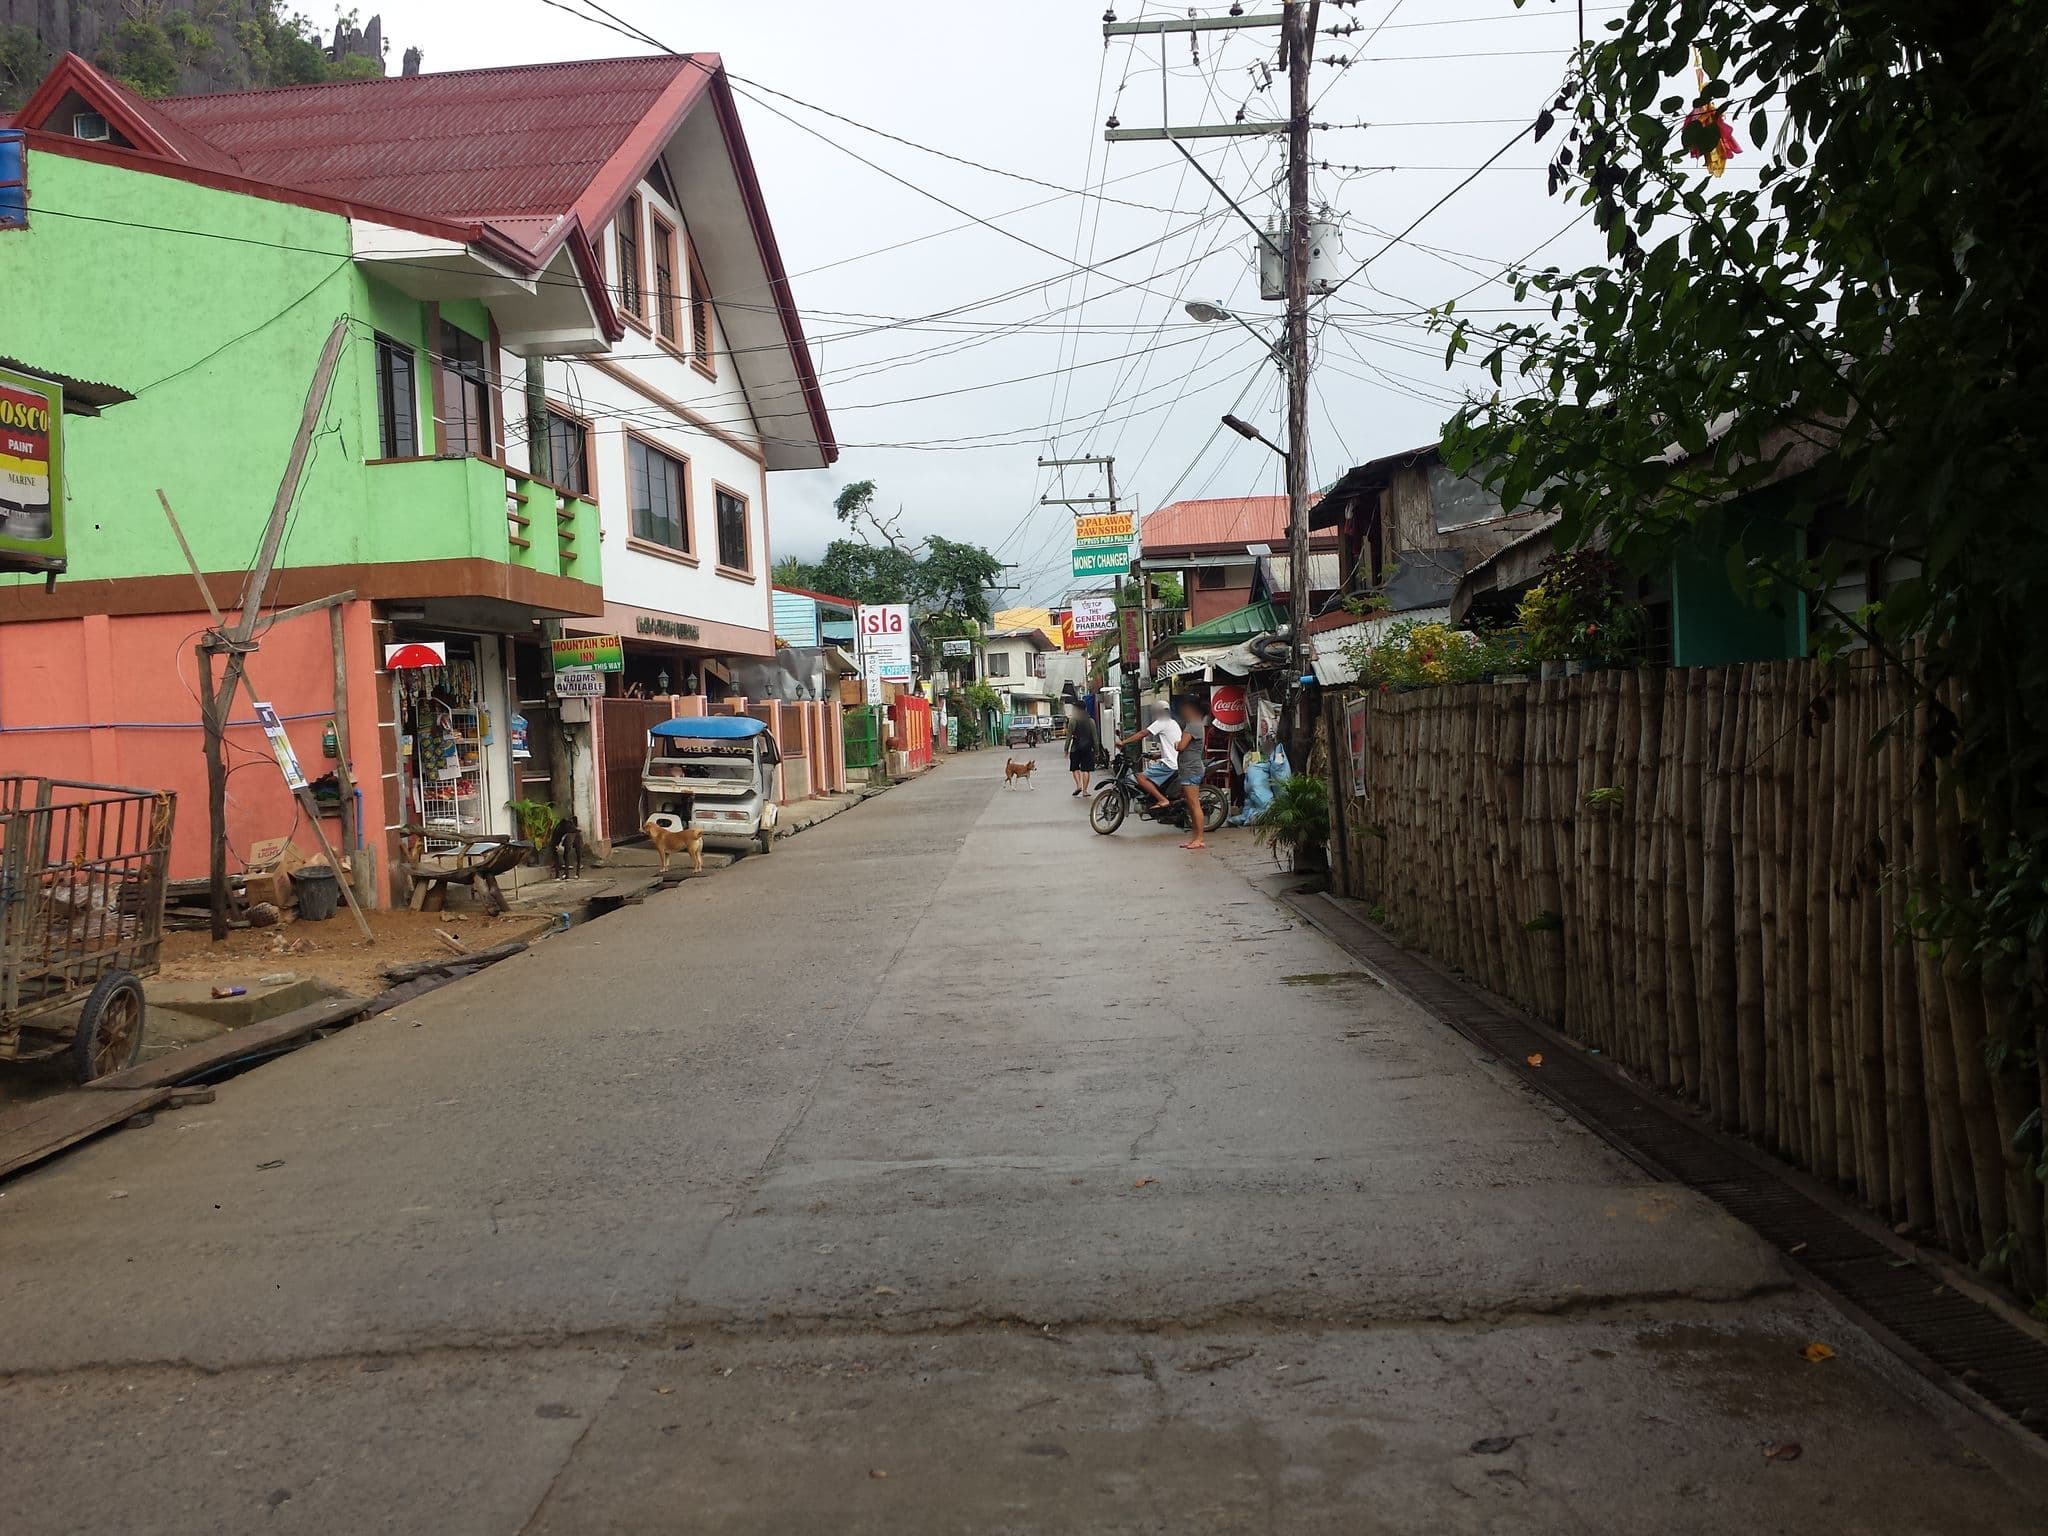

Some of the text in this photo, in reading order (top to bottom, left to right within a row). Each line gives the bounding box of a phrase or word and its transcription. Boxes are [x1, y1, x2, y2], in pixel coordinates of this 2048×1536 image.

[8, 438, 34, 454] PAINT
[8, 472, 36, 486] MARINE
[1086, 515, 1131, 527] PALAWAN
[1077, 524, 1131, 536] PAWNSHOP
[1073, 552, 1128, 570] MONEY CHANGER
[861, 608, 902, 634] isla
[1076, 620, 1115, 630] PHARMACY
[553, 634, 620, 652] MOUNTAIN SIDE
[580, 651, 595, 662] INN
[594, 661, 621, 671] THIS WAY
[887, 664, 910, 675] OFFICE
[564, 674, 596, 682] ROOMS
[557, 682, 603, 692] AVAILABLE
